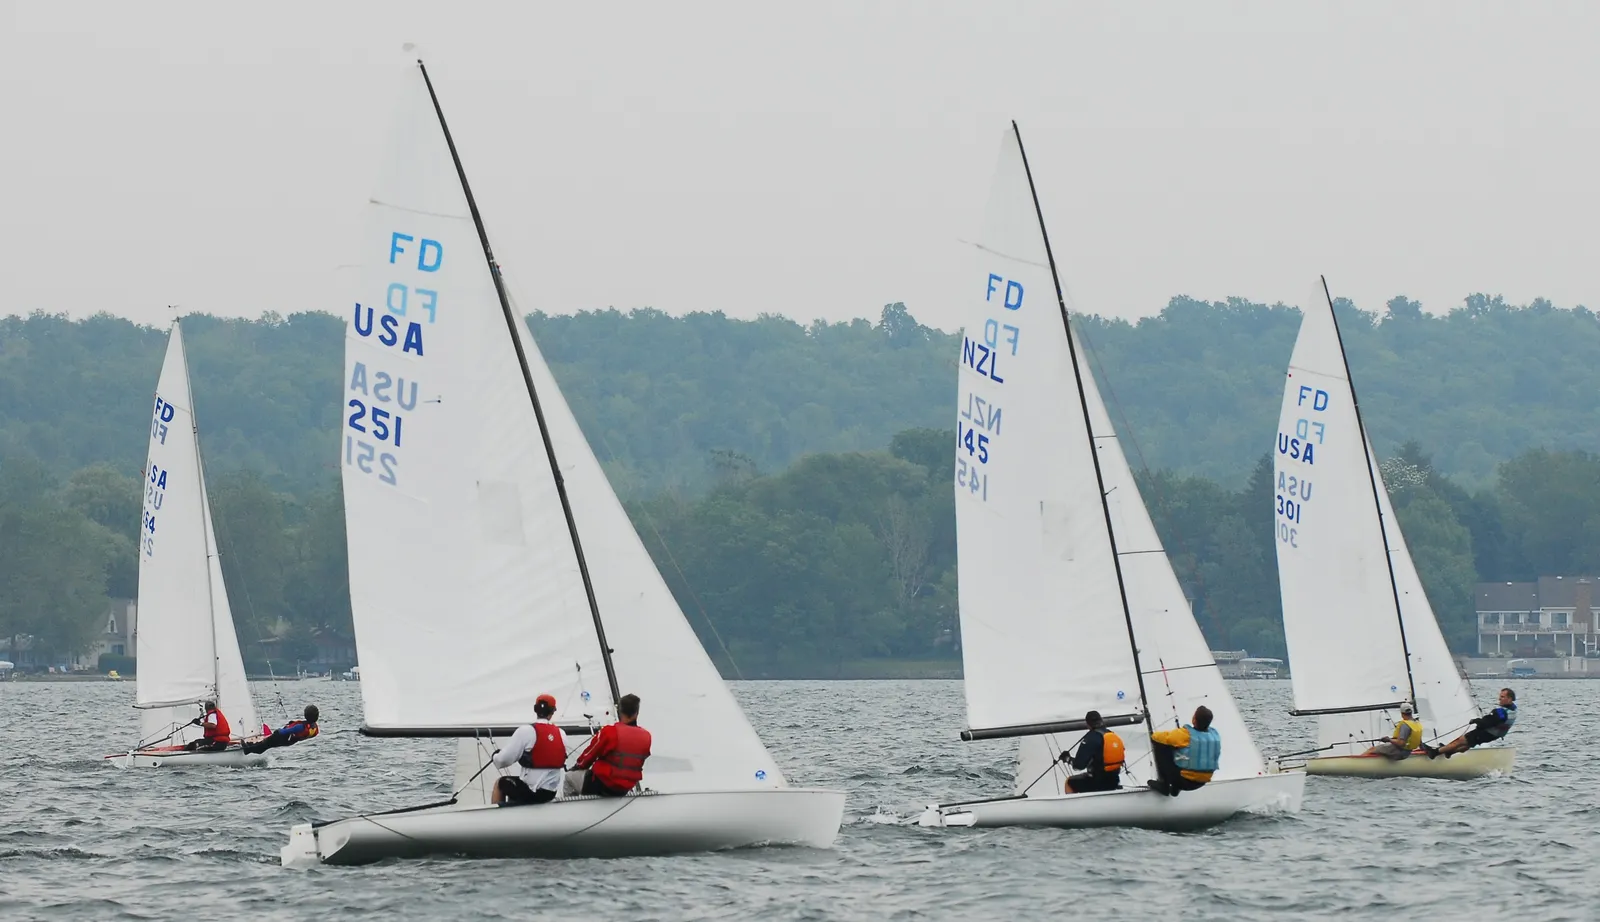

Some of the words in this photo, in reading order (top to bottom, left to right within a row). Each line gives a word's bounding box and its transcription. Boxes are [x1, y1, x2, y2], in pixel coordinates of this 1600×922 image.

[389, 231, 444, 273] FD
[986, 272, 1024, 311] FD
[354, 302, 424, 356] USA
[963, 336, 1004, 384] NZL
[154, 396, 175, 423] FD
[1298, 385, 1329, 412] FD
[348, 398, 402, 448] 251
[958, 421, 989, 464] 145
[1278, 432, 1314, 465] USA
[1276, 494, 1301, 524] 301
